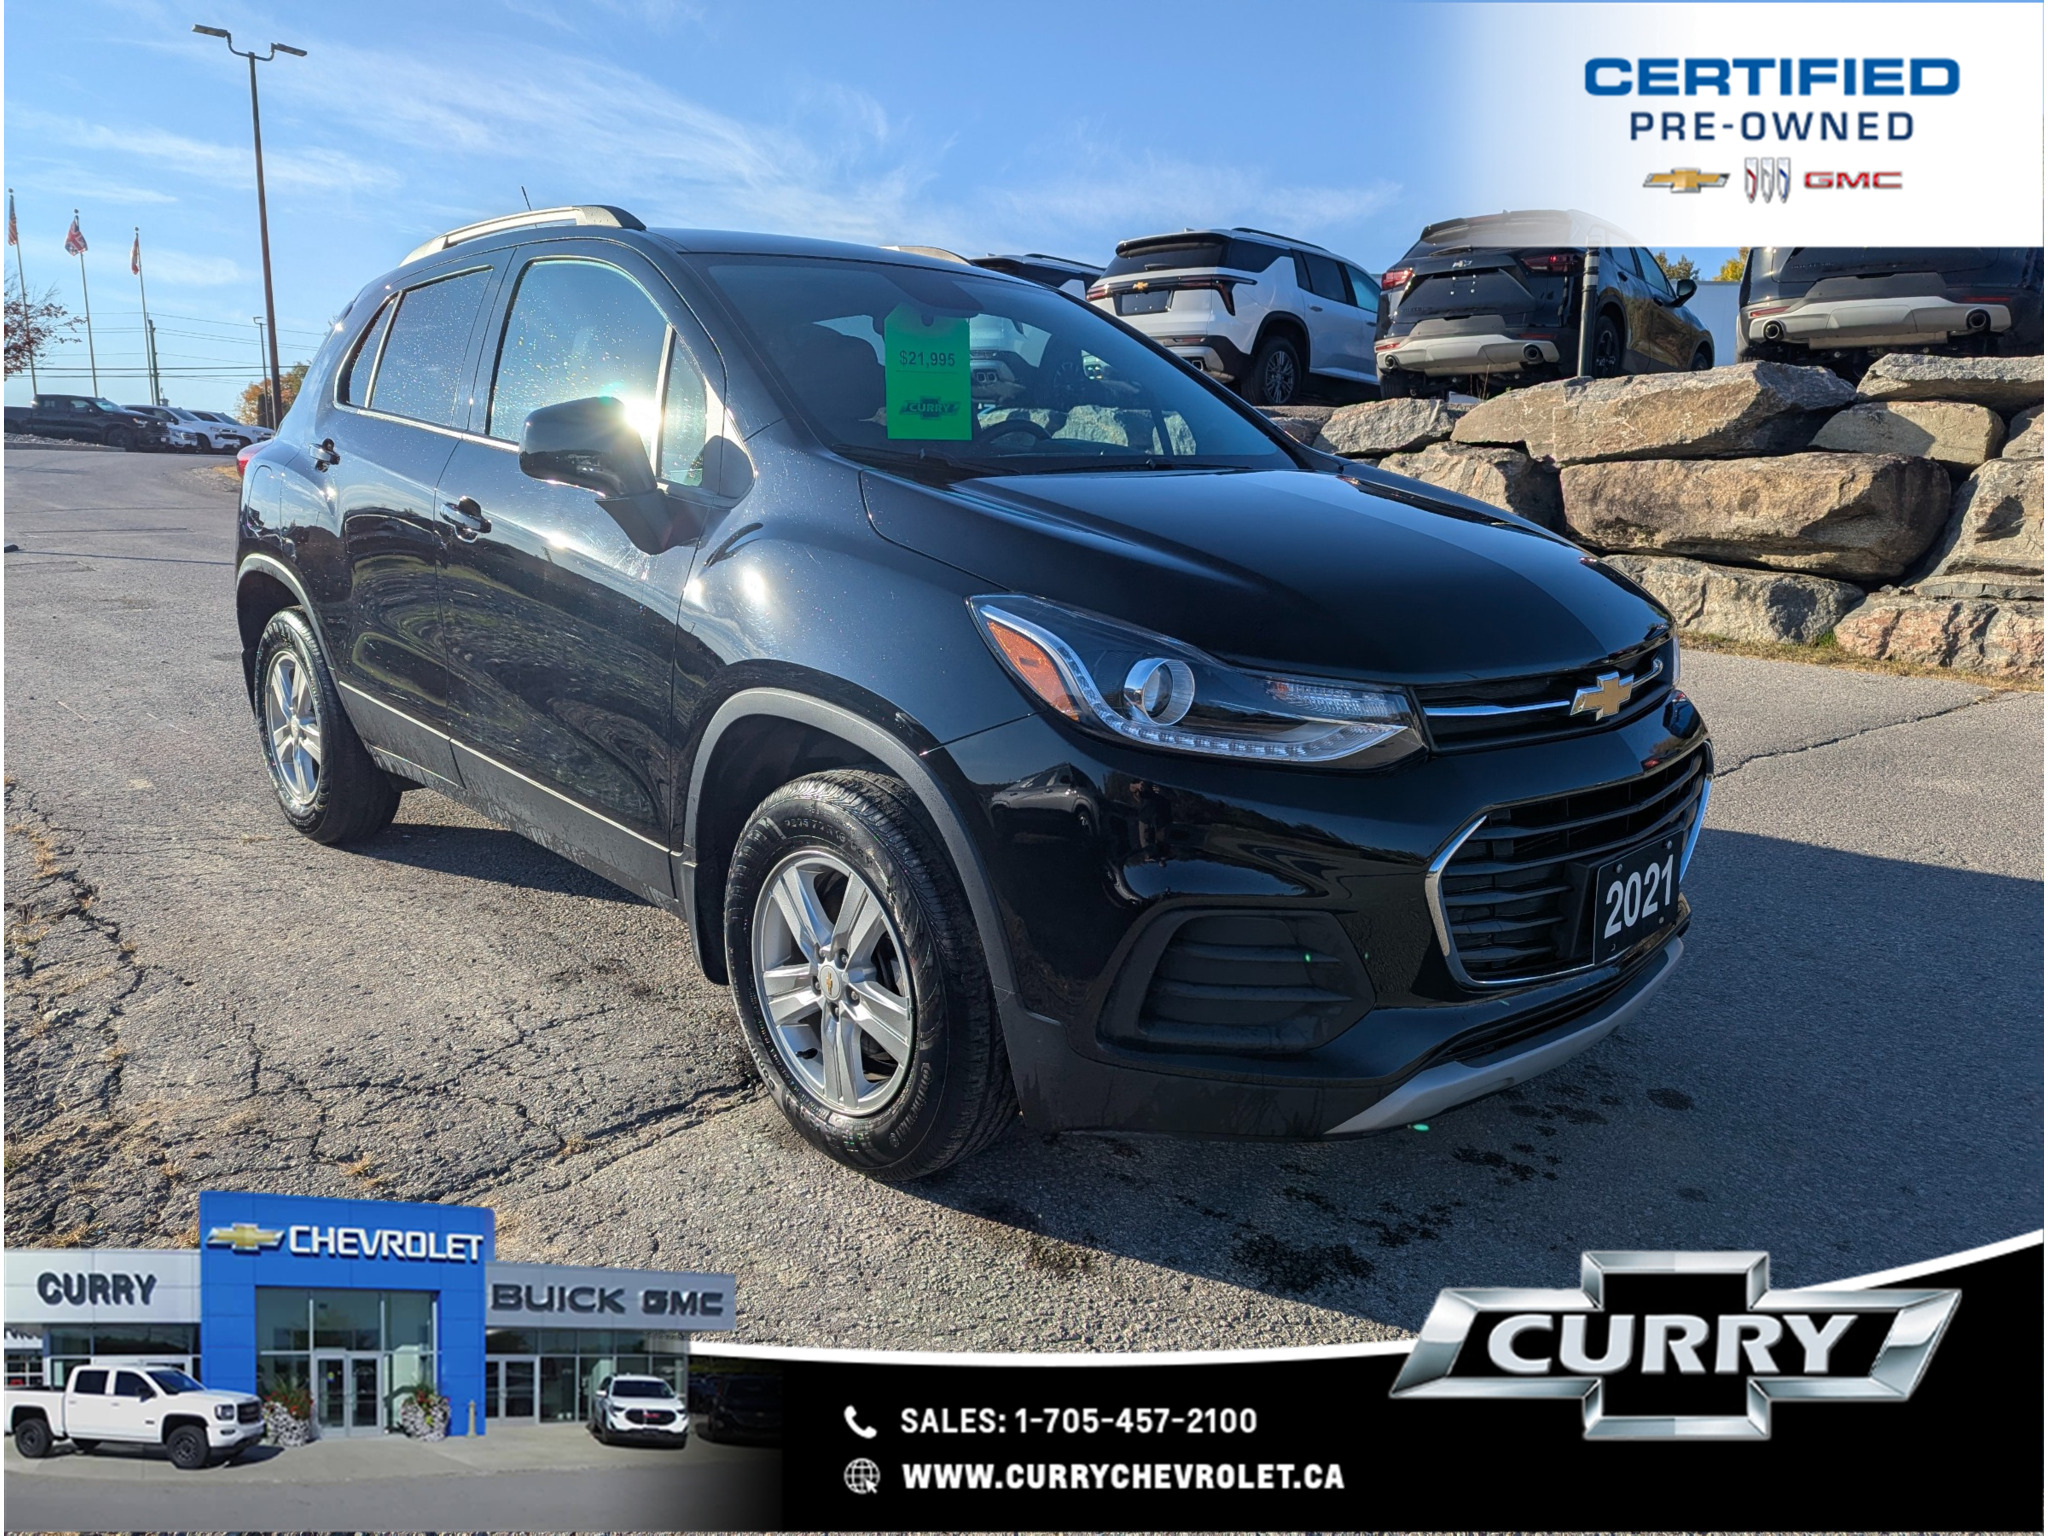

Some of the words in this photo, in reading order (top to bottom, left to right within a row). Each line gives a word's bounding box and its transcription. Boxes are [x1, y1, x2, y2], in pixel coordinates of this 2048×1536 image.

[899, 350, 956, 368] $21,995
[908, 402, 949, 413] CURRY
[1603, 853, 1674, 940] 2021
